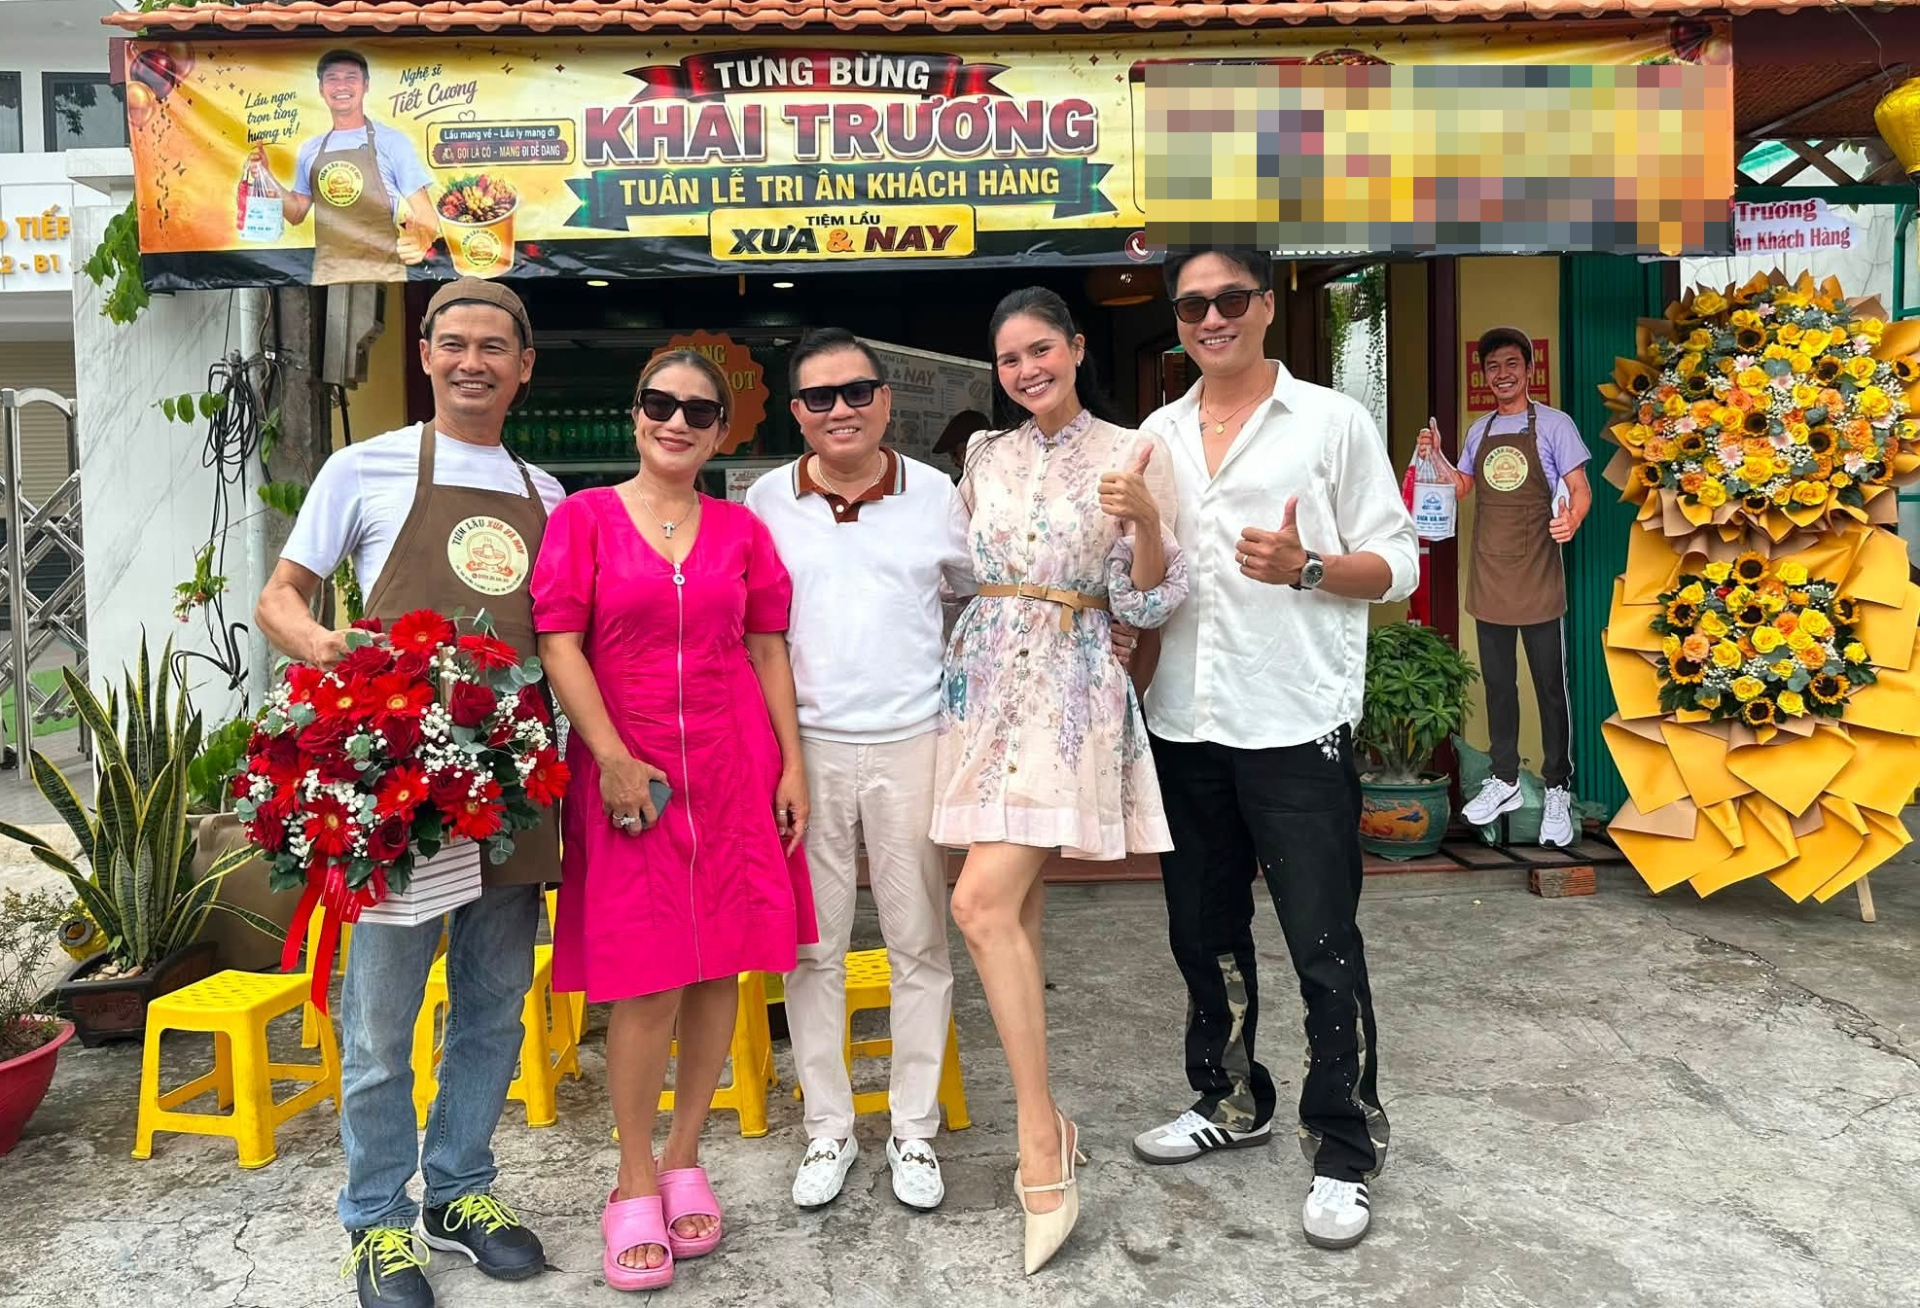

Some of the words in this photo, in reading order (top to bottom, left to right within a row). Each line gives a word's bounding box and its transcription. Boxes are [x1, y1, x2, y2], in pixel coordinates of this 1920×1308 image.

[400, 66, 429, 87] Nghệ
[431, 63, 442, 77] sĩ
[714, 56, 814, 89] TƯNG
[830, 51, 930, 90] BỪNG
[270, 91, 297, 108] ngon
[388, 88, 423, 118] Tiết
[427, 80, 478, 105] Cương
[247, 112, 271, 125] trọn
[247, 129, 279, 143] hương
[460, 130, 481, 141] mang
[516, 128, 523, 140] ly
[525, 129, 546, 139] mang
[547, 128, 556, 137] đi
[583, 101, 767, 165] KHAI
[783, 95, 1098, 160] TRƯƠNG
[499, 146, 520, 158] MANG
[521, 146, 530, 157] ĐI
[619, 171, 699, 206] TUẦN
[711, 168, 746, 204] LỄ
[756, 175, 803, 202] TRI
[815, 168, 855, 200] ÂN
[867, 166, 967, 199] KHÁCH
[978, 163, 1060, 196] HÀNG
[805, 214, 845, 228] TIỆM
[849, 211, 880, 226] LẨU
[1736, 199, 1816, 222] Trương
[729, 224, 819, 255] XƯA
[826, 228, 856, 253] &
[864, 224, 958, 253] NAY
[1757, 229, 1804, 250] Khách
[1810, 226, 1850, 249] Hàng
[675, 343, 727, 364] NG
[904, 366, 936, 386] NAY
